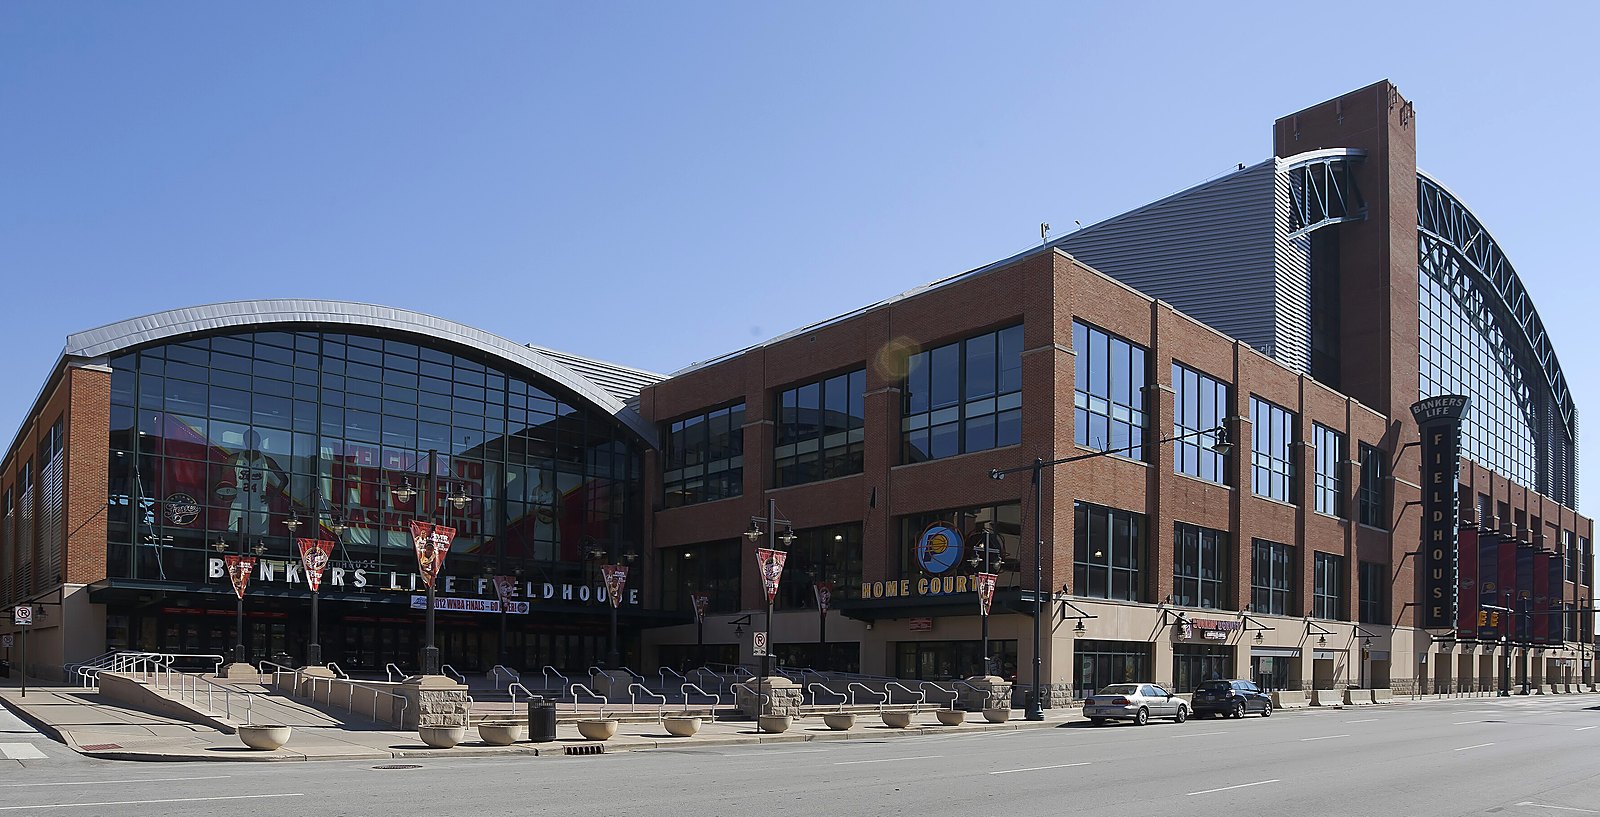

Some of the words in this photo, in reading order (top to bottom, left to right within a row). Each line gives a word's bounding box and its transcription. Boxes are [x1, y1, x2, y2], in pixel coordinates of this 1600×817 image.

[1413, 398, 1463, 414] BANKERS
[1426, 407, 1449, 418] LIFE
[242, 483, 258, 493] 24
[1433, 433, 1443, 618] FIELDHOUSE
[209, 557, 367, 588] BNKRS
[390, 571, 457, 594] LIE
[477, 578, 640, 605] FELDHOUE
[861, 579, 910, 599] HOME
[917, 575, 980, 596] COURT
[434, 599, 446, 610] 012
[447, 599, 465, 611] WNBA
[465, 600, 485, 612] FINALS
[490, 602, 499, 612] GO
